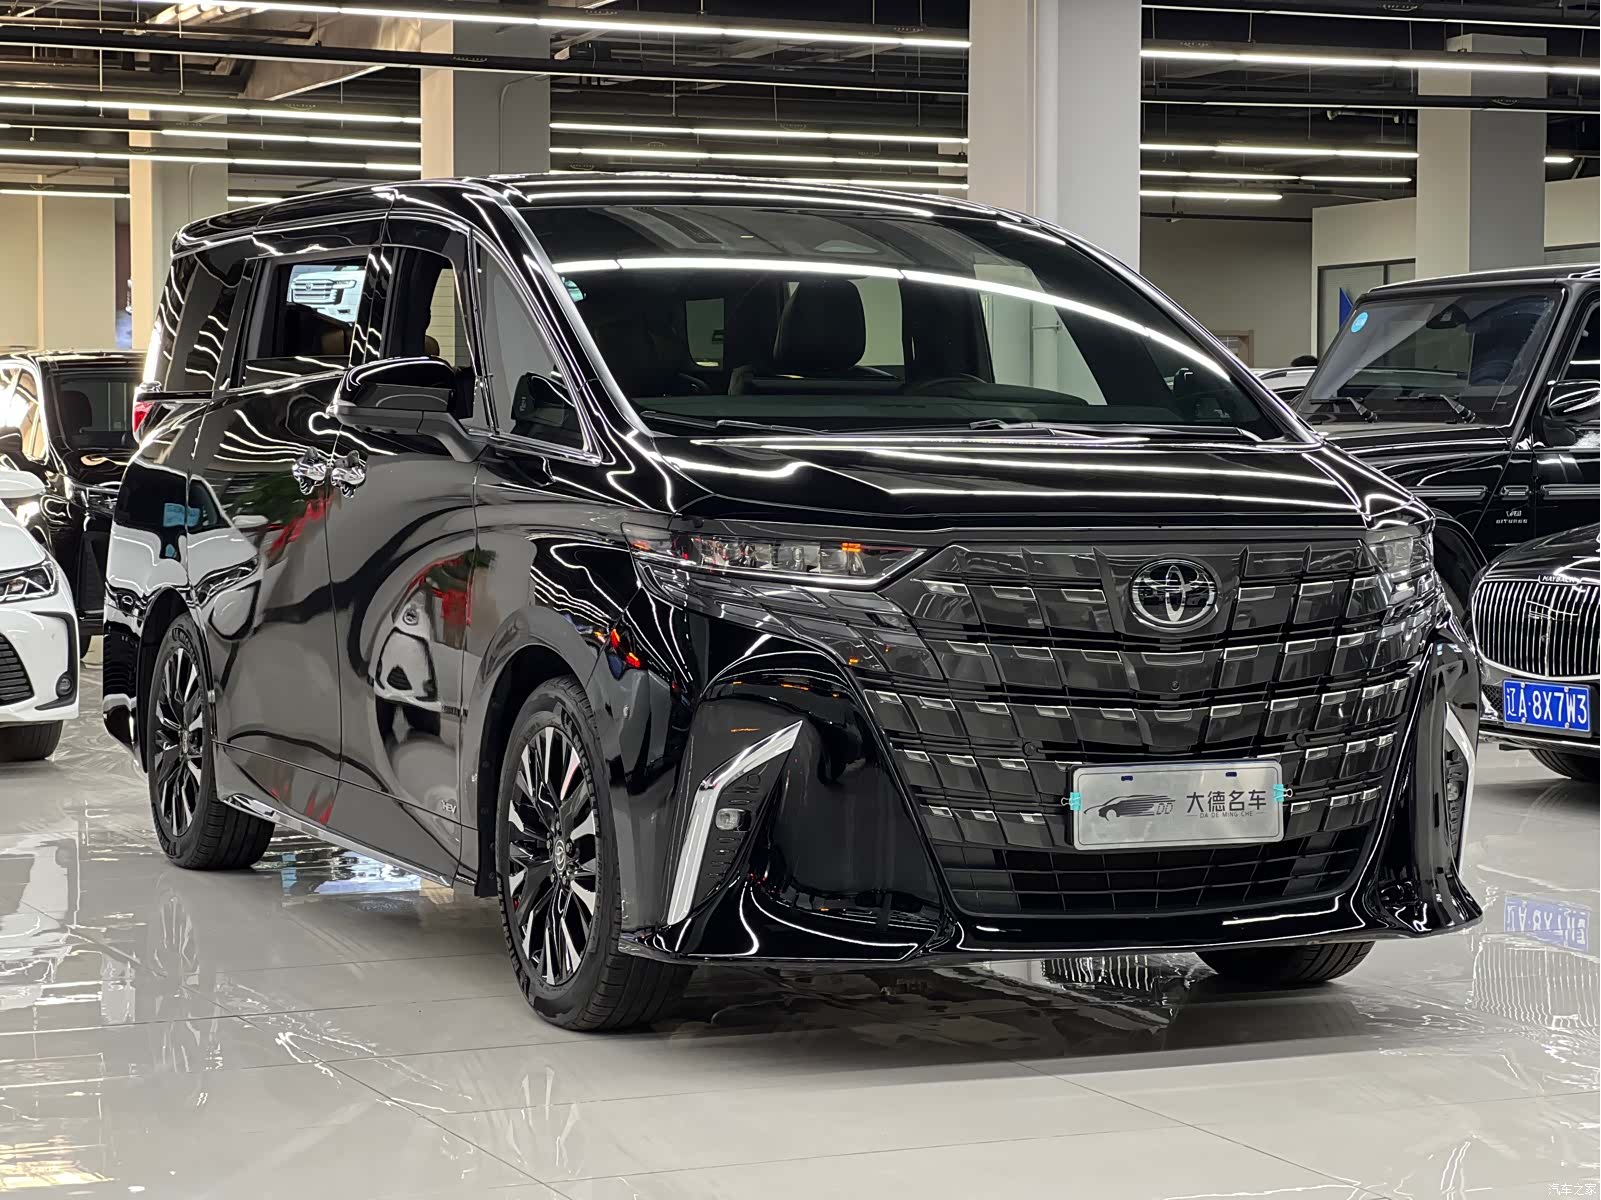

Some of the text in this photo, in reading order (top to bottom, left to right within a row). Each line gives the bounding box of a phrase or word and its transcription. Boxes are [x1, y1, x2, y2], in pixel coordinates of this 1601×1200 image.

[1542, 575, 1577, 583] MAYBACH
[1186, 789, 1267, 813] 大德名车
